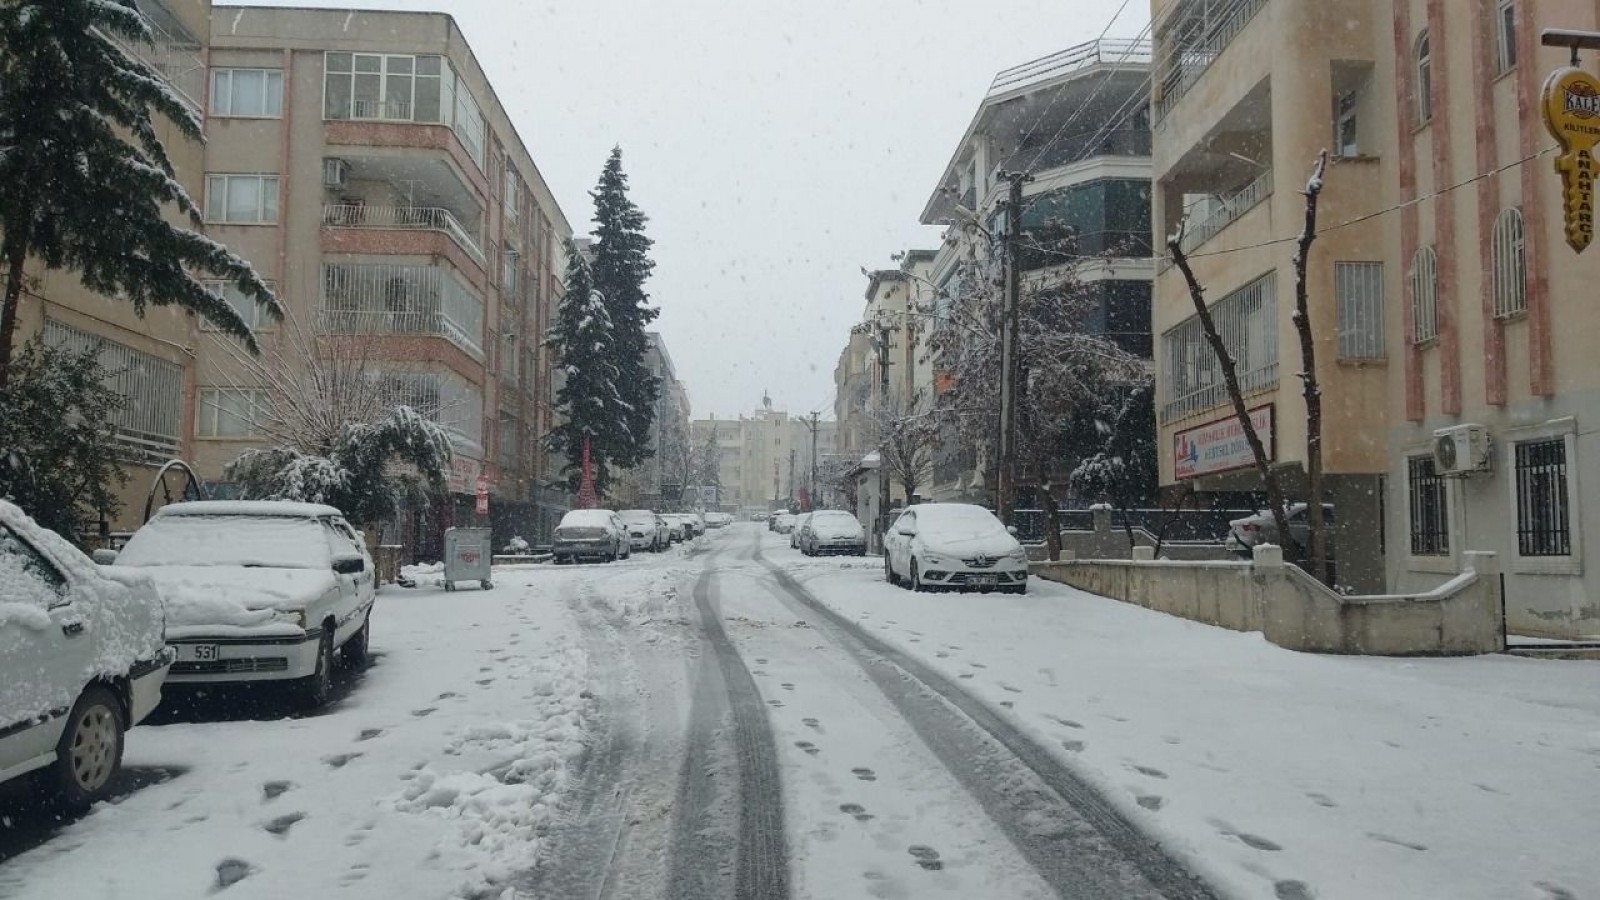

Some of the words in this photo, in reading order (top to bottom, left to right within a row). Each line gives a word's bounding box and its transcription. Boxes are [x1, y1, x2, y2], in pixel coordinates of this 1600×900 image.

[1565, 91, 1600, 114] KALE
[1578, 150, 1592, 243] ANAHTARCI
[195, 645, 216, 659] 531
